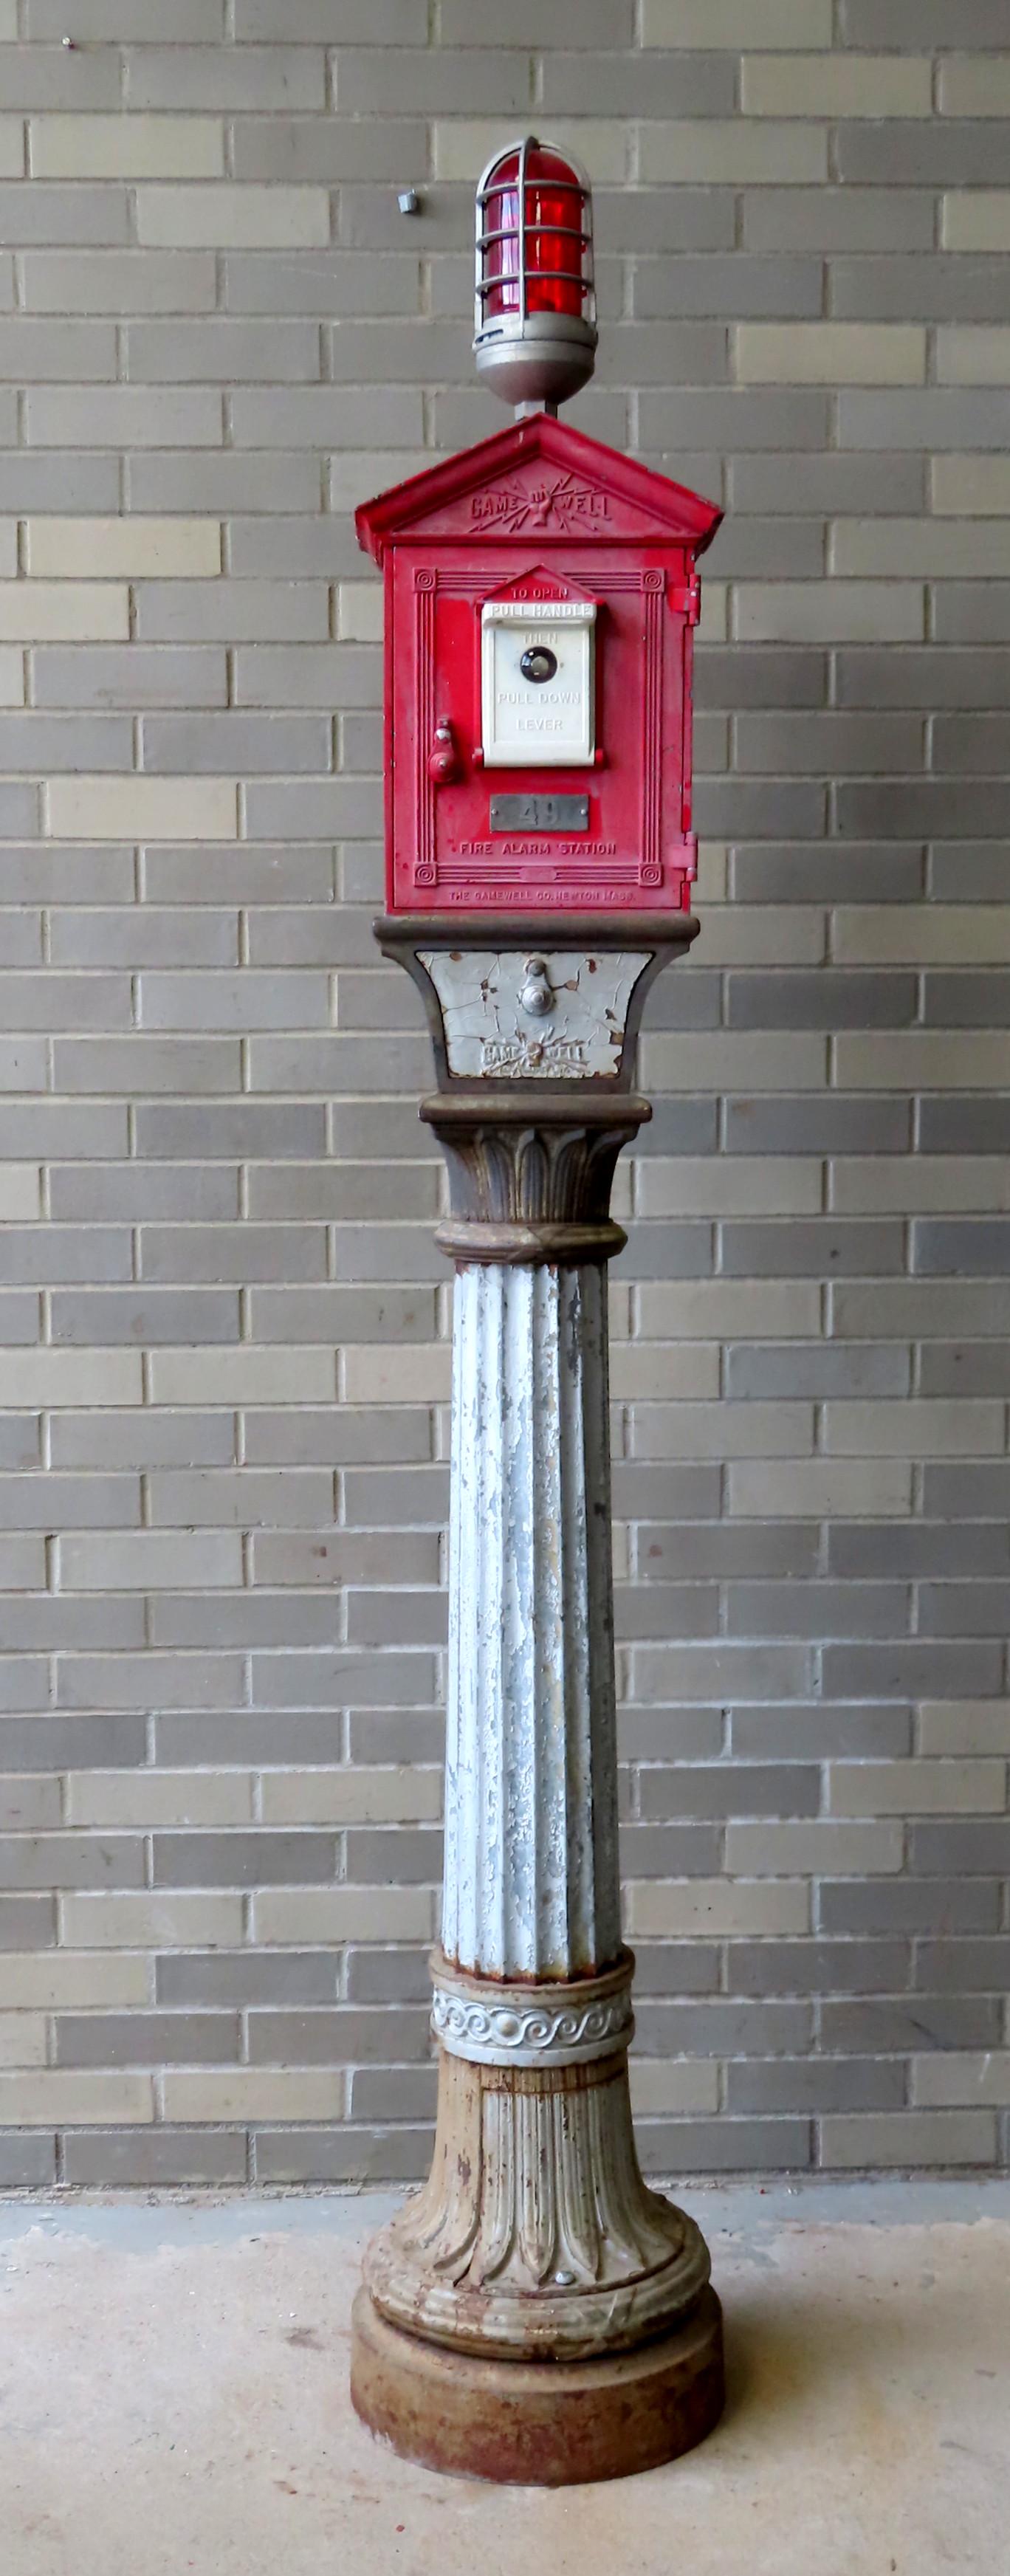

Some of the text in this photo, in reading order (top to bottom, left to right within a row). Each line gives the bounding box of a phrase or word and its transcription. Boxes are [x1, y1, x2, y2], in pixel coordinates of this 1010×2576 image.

[471, 495, 613, 521] GAME WELL
[511, 588, 568, 600] TO OPEN
[492, 605, 591, 616] PULL HANDLE
[523, 632, 558, 645] THEN
[497, 693, 581, 704] PULL DOWN
[516, 719, 563, 731] LEVER
[519, 800, 559, 825] 49
[460, 842, 616, 855] FIRE ALARM STATION
[449, 891, 470, 900] THE
[474, 891, 532, 901] GAMEWELL
